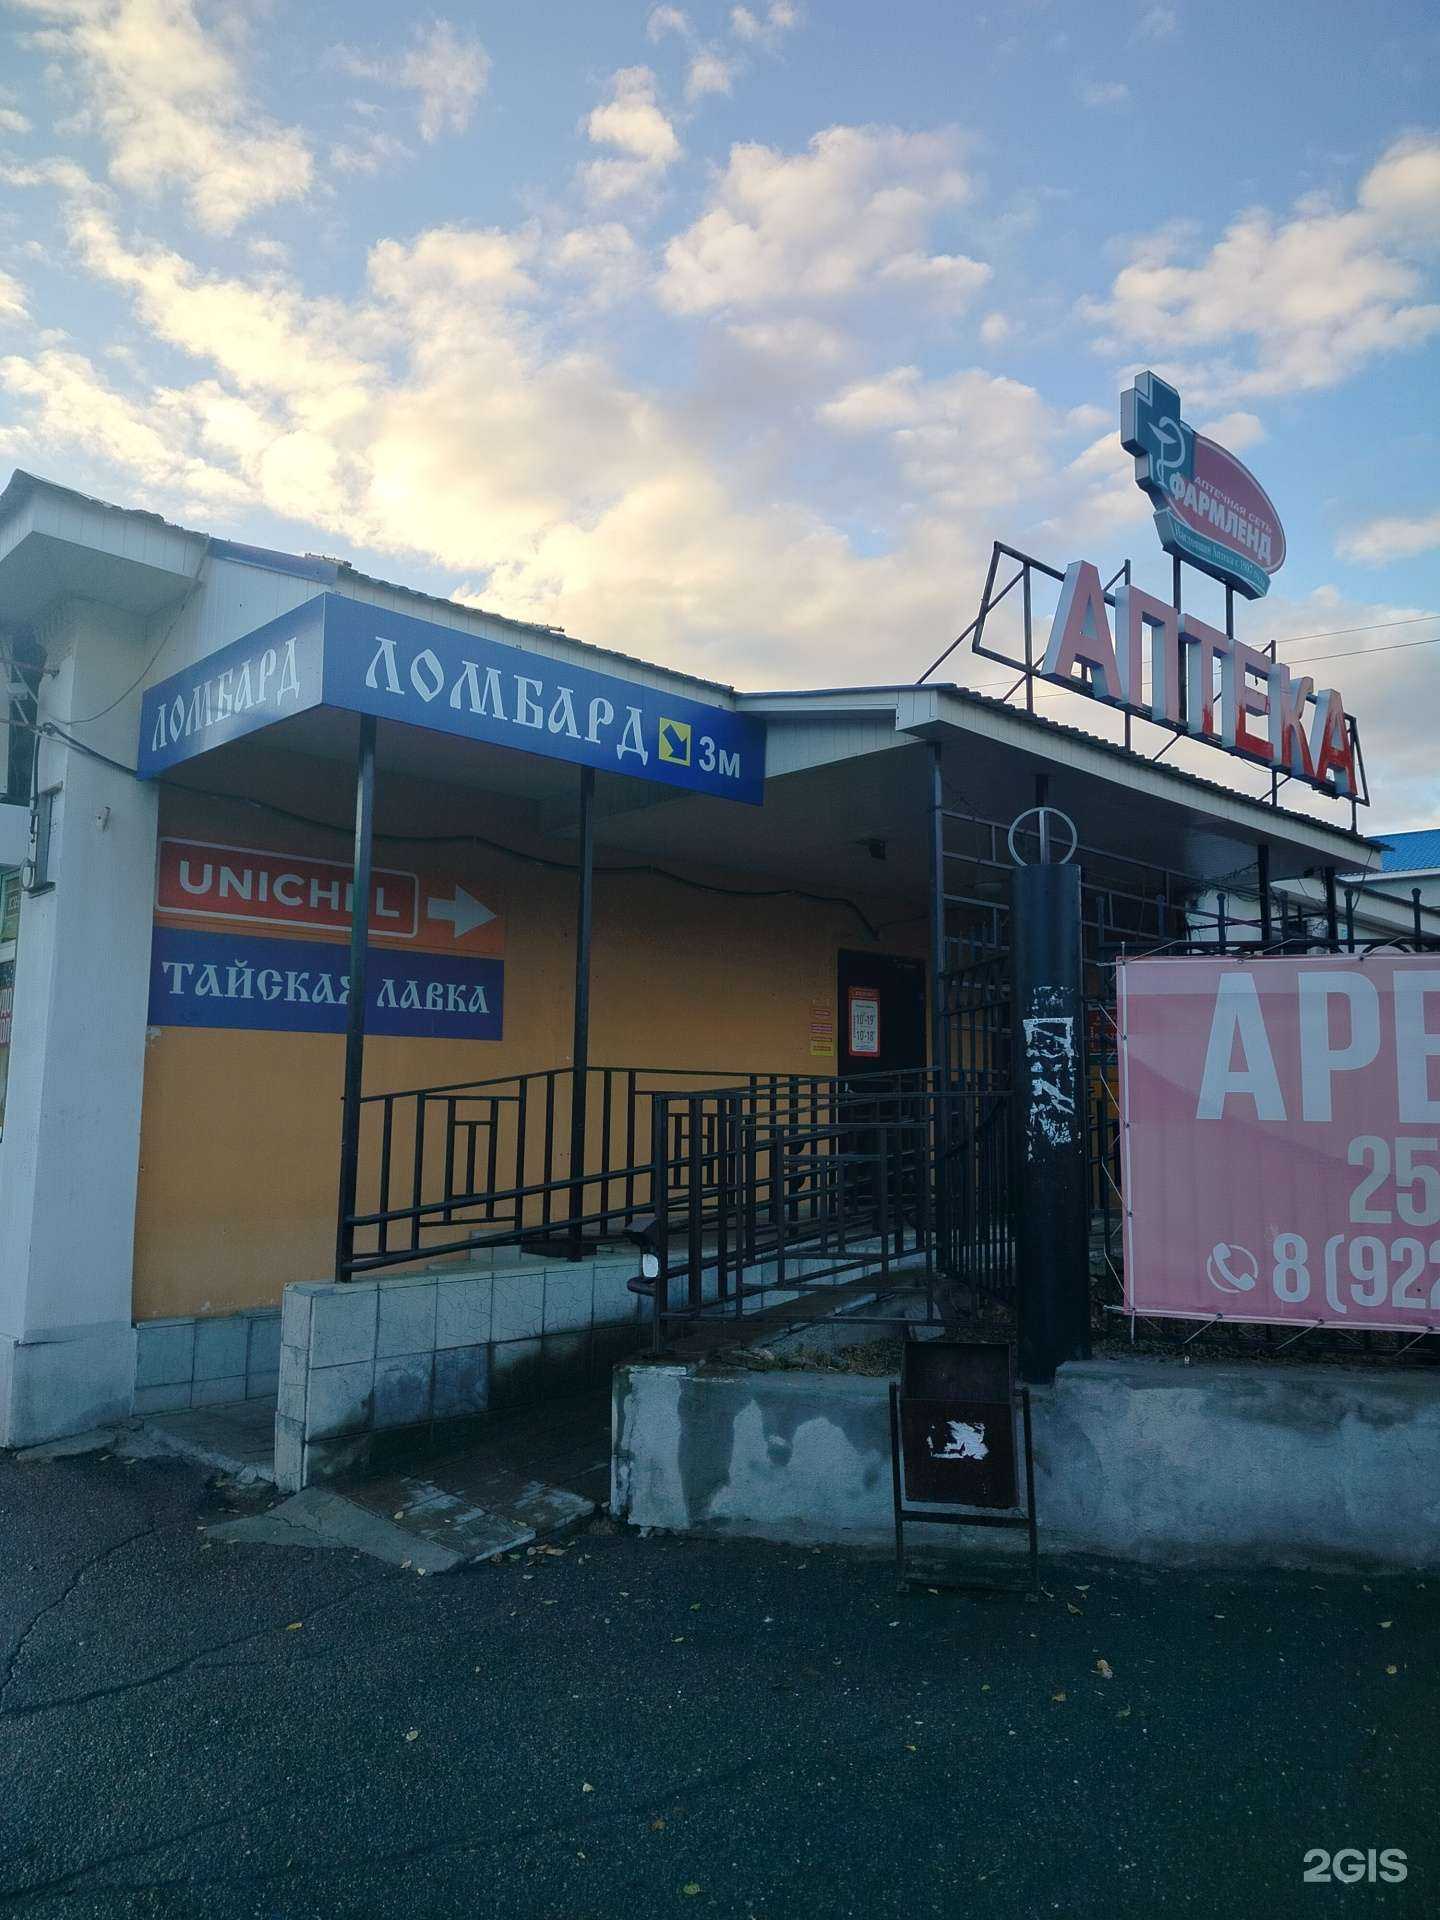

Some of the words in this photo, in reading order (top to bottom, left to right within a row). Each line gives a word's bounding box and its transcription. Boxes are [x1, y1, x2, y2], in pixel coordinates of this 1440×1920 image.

[1169, 472, 1273, 566] ФАРМЛЕНД
[152, 637, 300, 752] ЛОМБАРД
[365, 636, 649, 766] ЛОМБАРД
[1041, 560, 1358, 797] АПТЕКА
[376, 978, 490, 1014] ЛАВКА
[1347, 1135, 1440, 1227] 25
